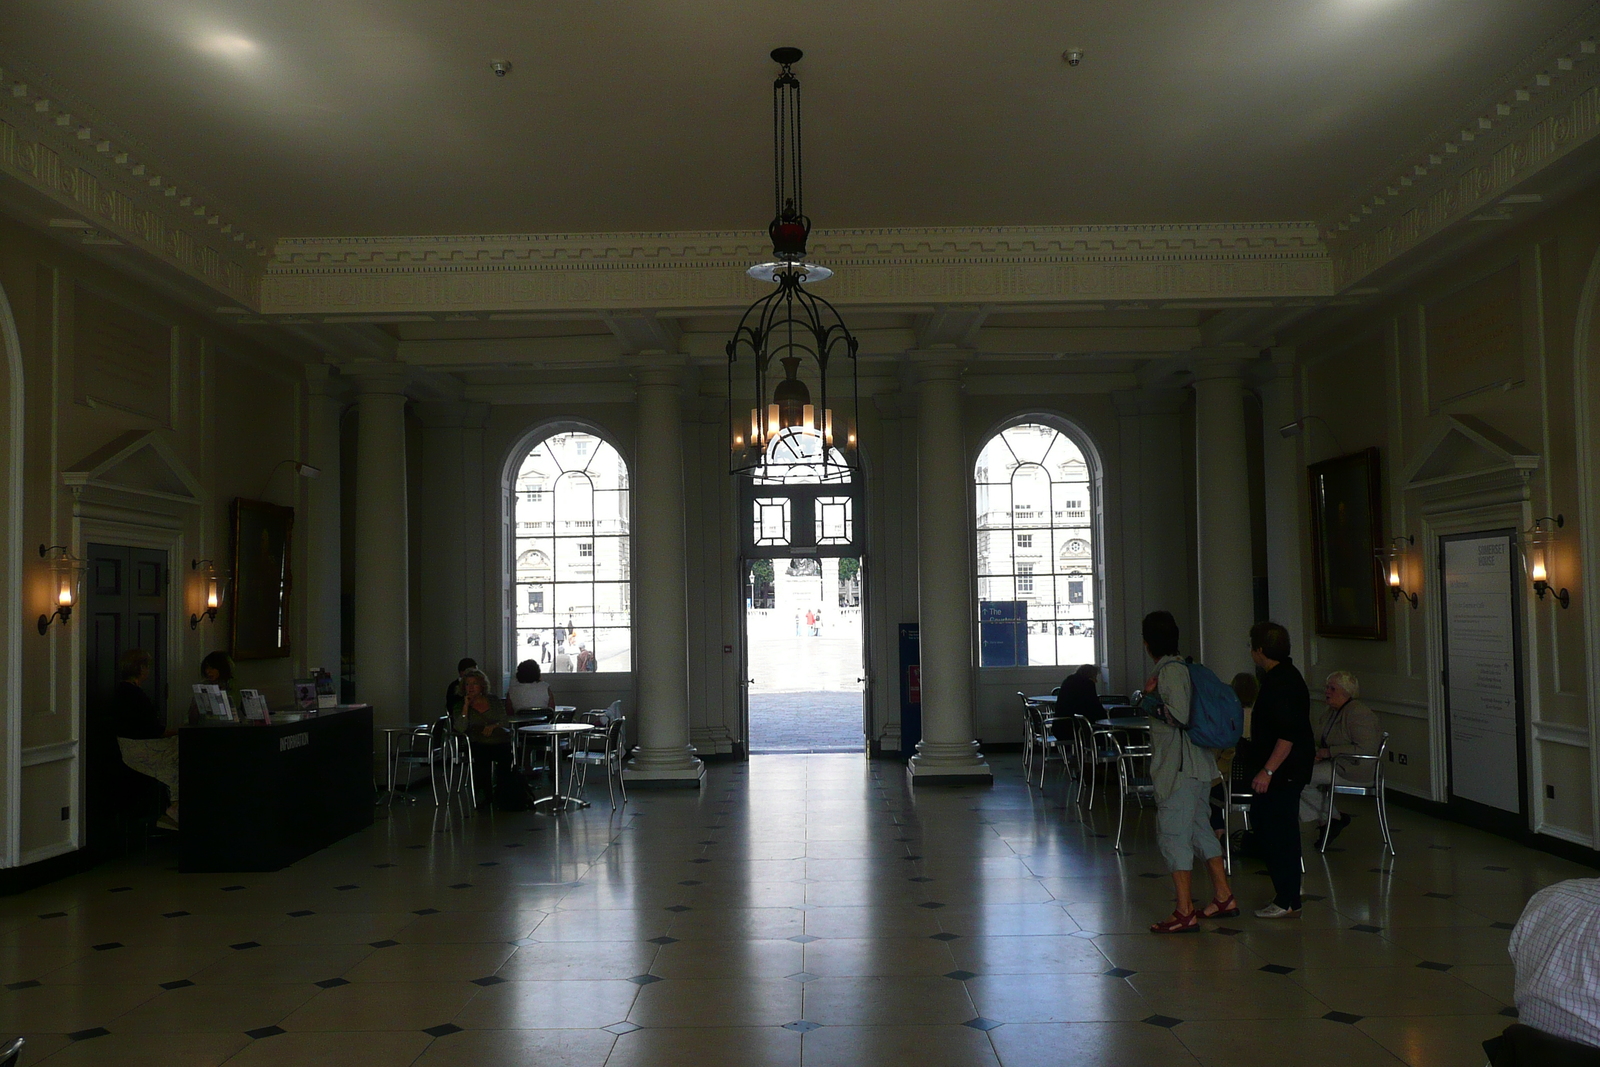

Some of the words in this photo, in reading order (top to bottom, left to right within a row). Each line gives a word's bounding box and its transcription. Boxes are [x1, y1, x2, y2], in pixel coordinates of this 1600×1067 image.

[1477, 543, 1505, 555] SOMERSET
[989, 607, 1002, 616] The
[279, 731, 309, 752] INFORMATION
